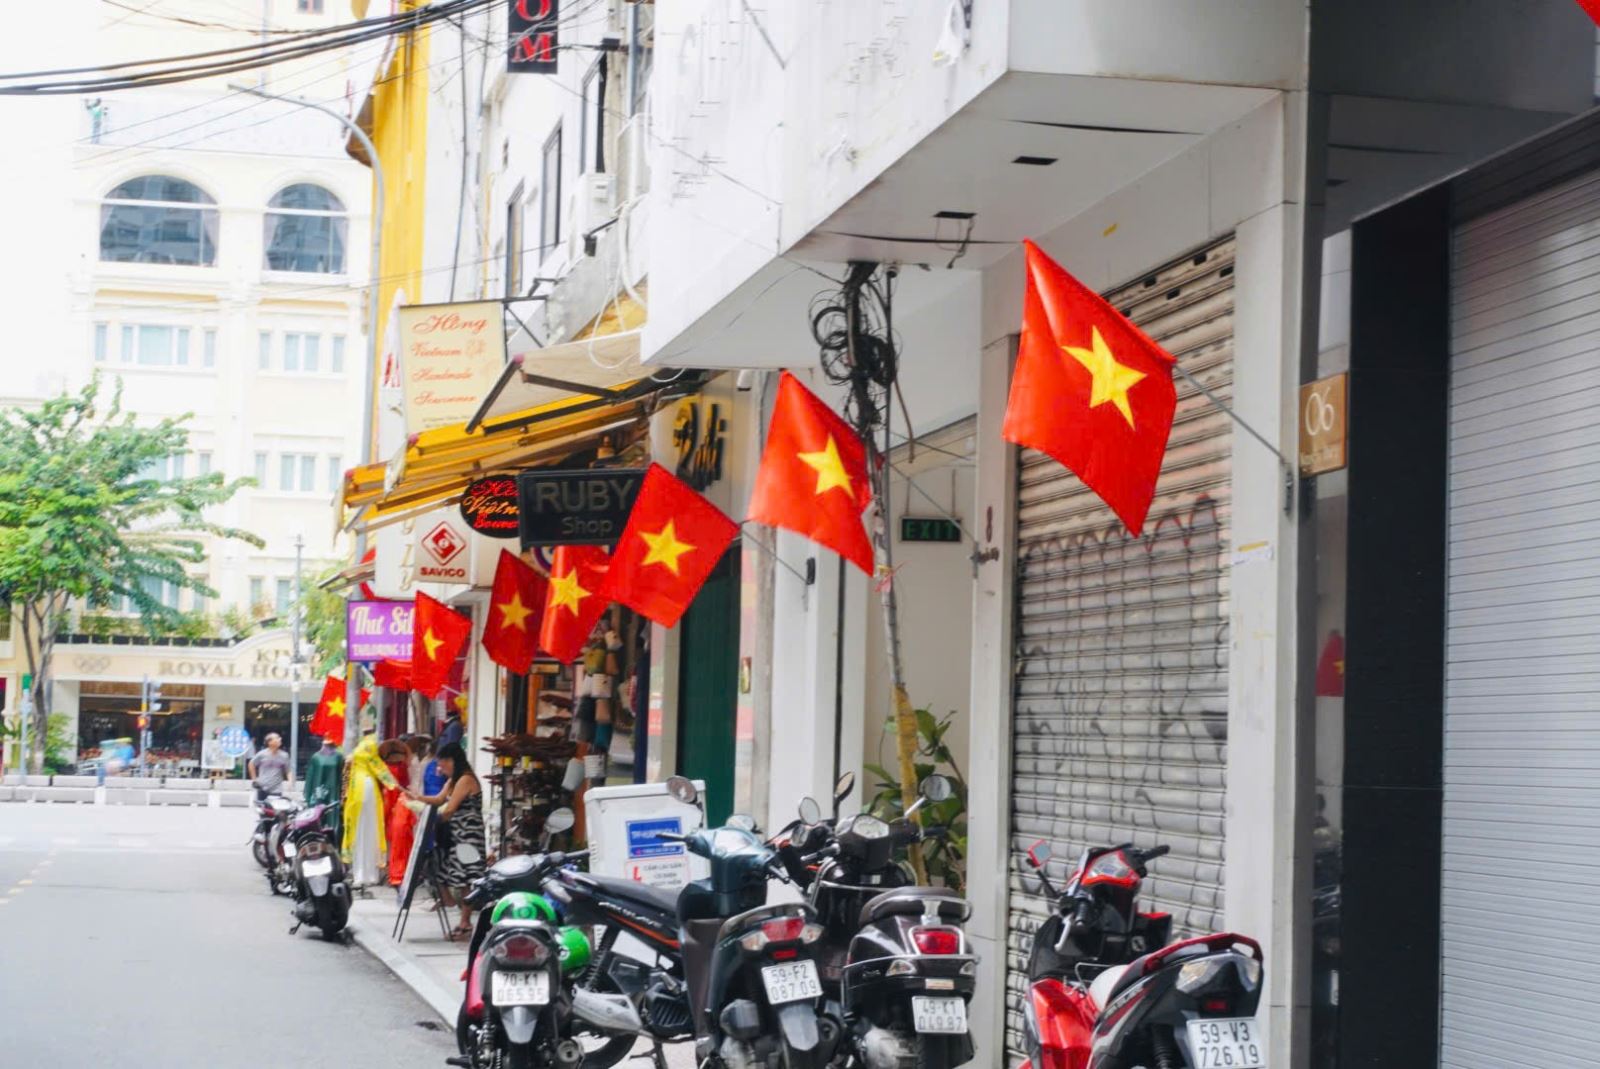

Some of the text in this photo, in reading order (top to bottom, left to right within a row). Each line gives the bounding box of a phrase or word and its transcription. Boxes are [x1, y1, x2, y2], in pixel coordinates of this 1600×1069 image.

[1305, 386, 1335, 436] 06
[534, 479, 635, 513] RUBY
[561, 516, 613, 538] Shop
[905, 520, 959, 539] EXIT
[420, 567, 466, 578] SAVICO
[158, 660, 243, 678] ROYAL
[1200, 1022, 1250, 1044] 59-V3
[1199, 1044, 1260, 1067] 726.19
